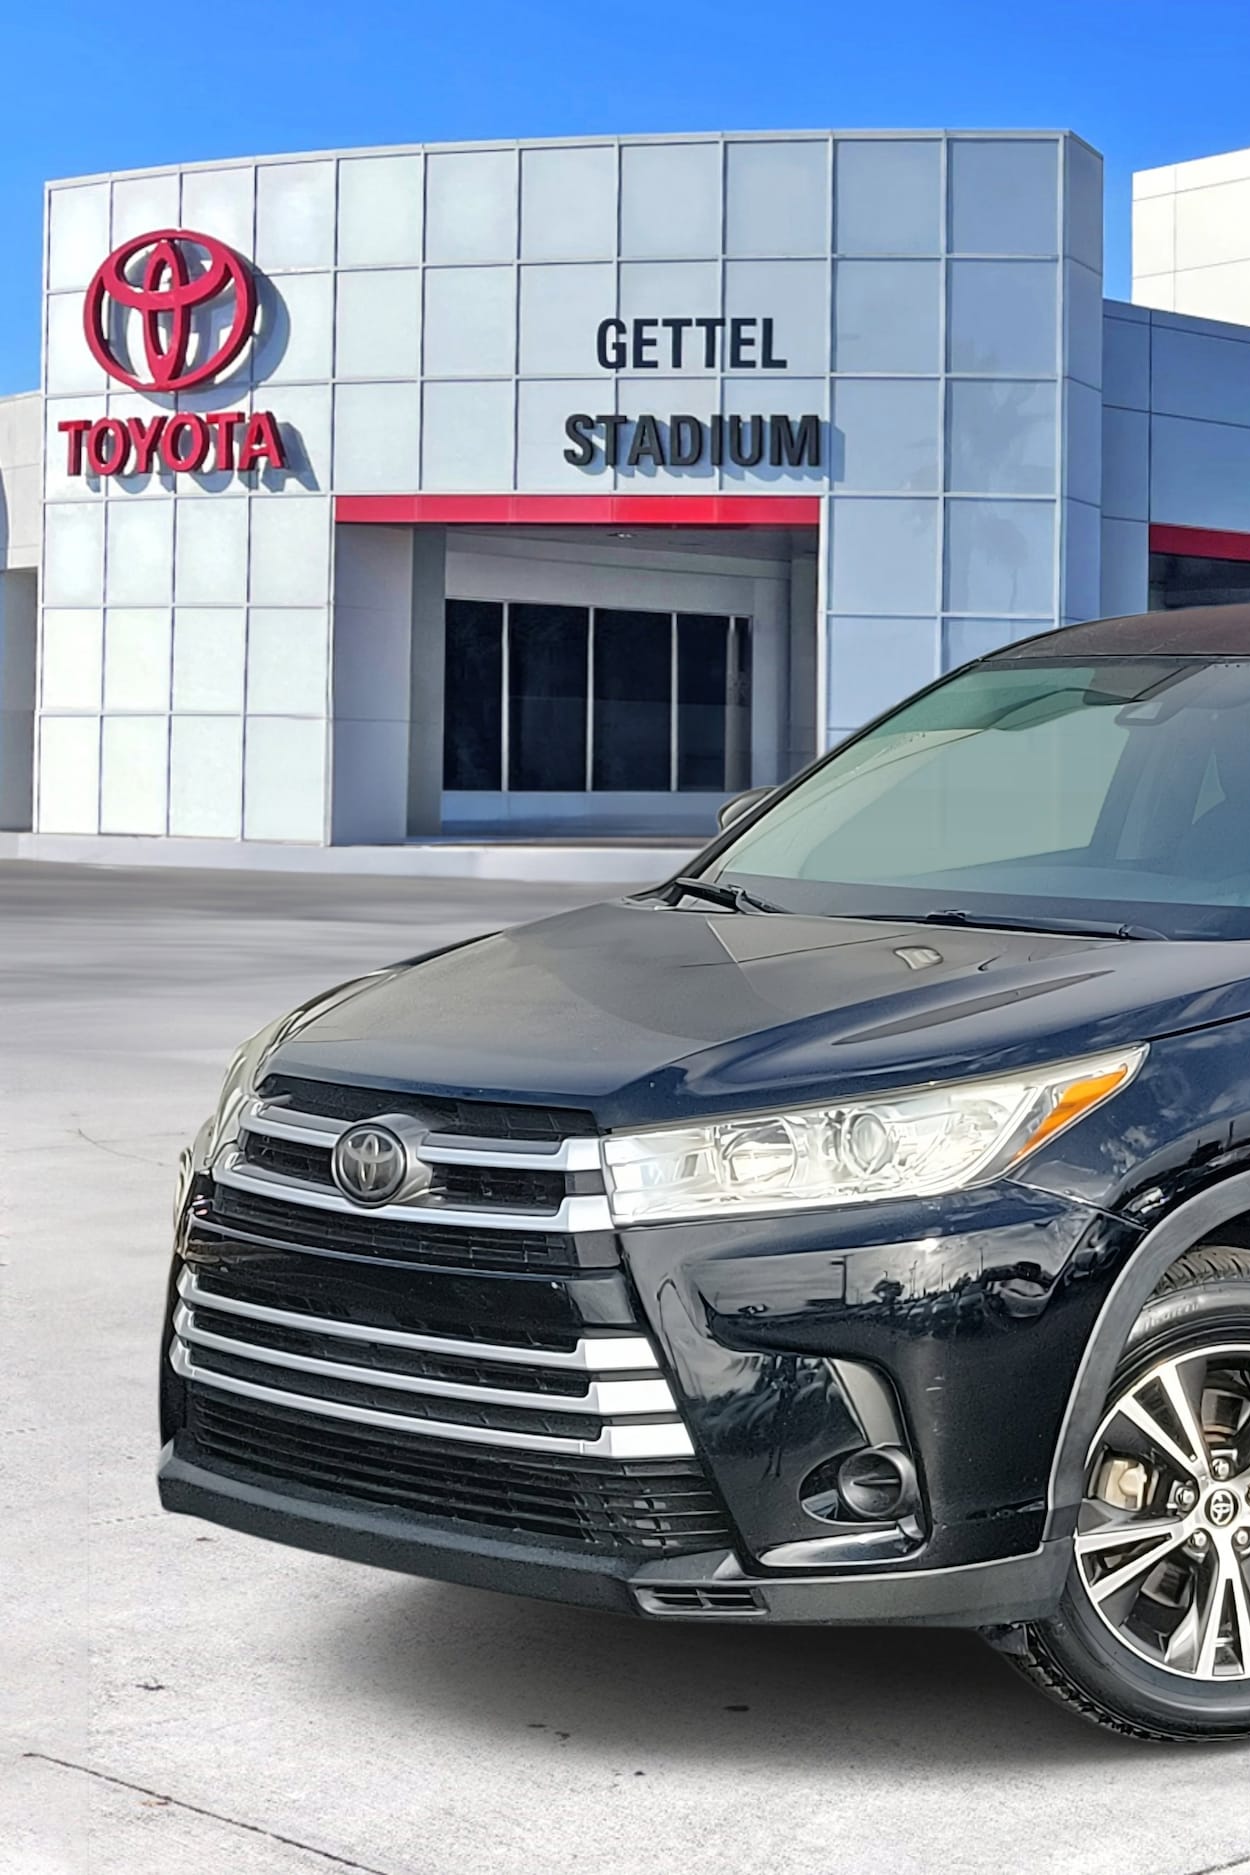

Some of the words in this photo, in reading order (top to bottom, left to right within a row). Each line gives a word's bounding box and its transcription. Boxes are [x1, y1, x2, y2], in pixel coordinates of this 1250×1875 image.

[597, 318, 787, 369] GETTEL
[58, 411, 287, 476] TOYOTA
[563, 414, 820, 466] STADIUM
